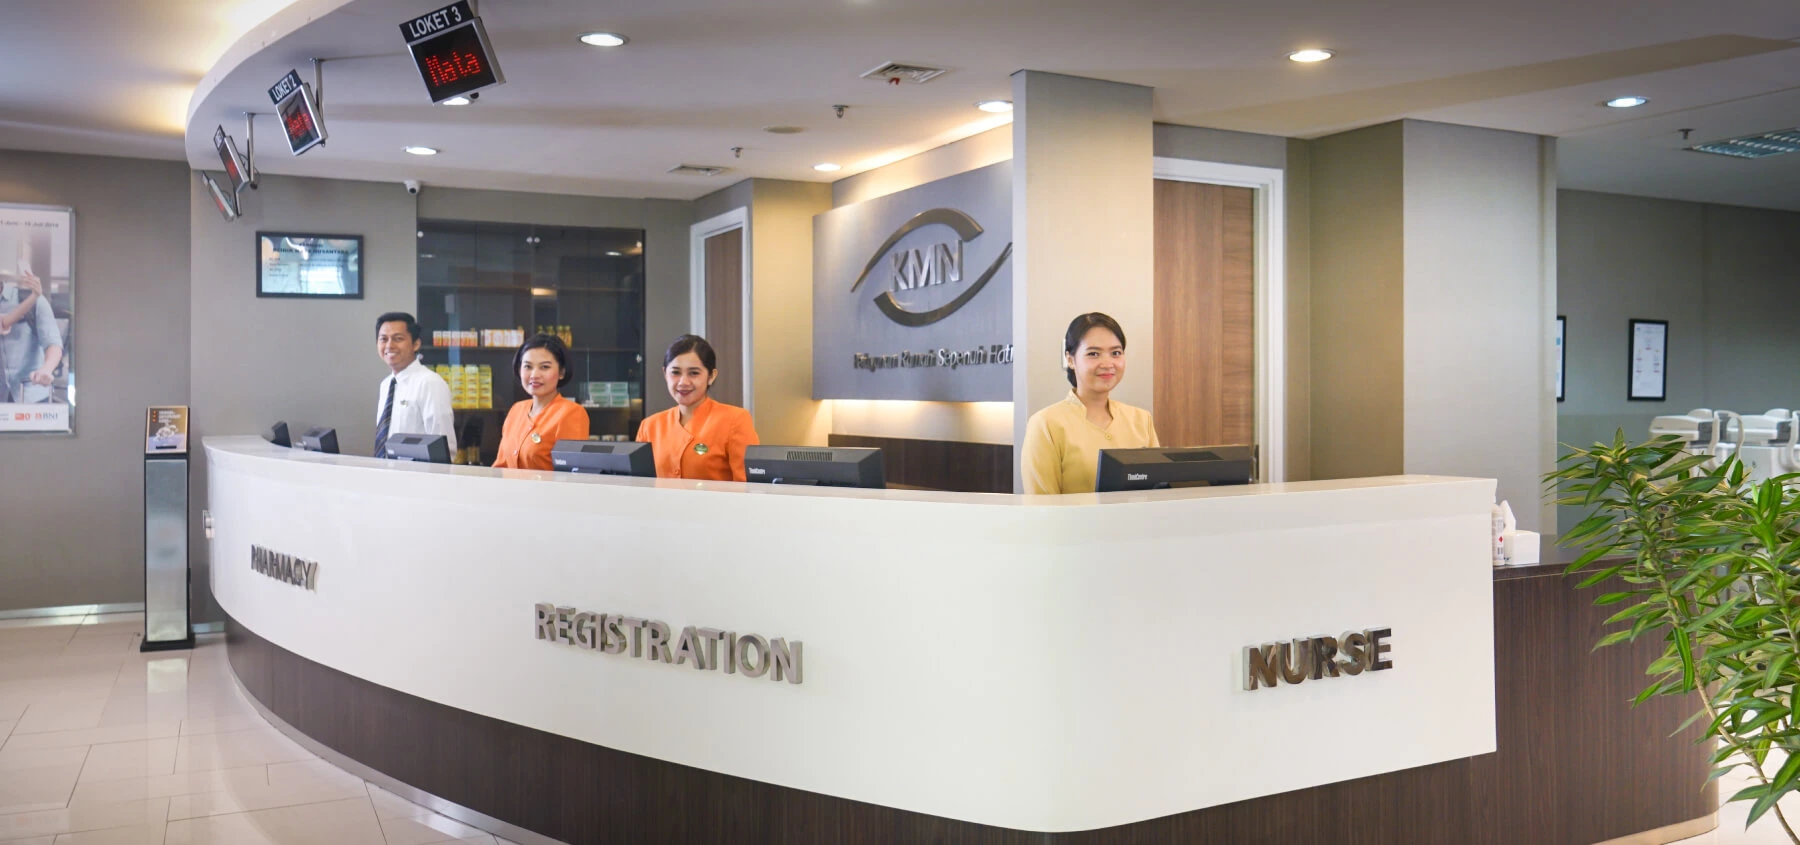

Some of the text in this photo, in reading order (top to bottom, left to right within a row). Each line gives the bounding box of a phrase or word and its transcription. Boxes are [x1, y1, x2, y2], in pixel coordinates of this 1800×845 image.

[409, 6, 462, 38] LOKET 3
[272, 74, 297, 102] LOKET 2
[425, 51, 481, 87] Mata
[889, 240, 963, 292] KMN
[938, 346, 987, 370] Sepenuh
[251, 544, 318, 592] PHARMACY
[535, 602, 803, 685] REGISTRATION
[1243, 627, 1393, 692] NURSE
